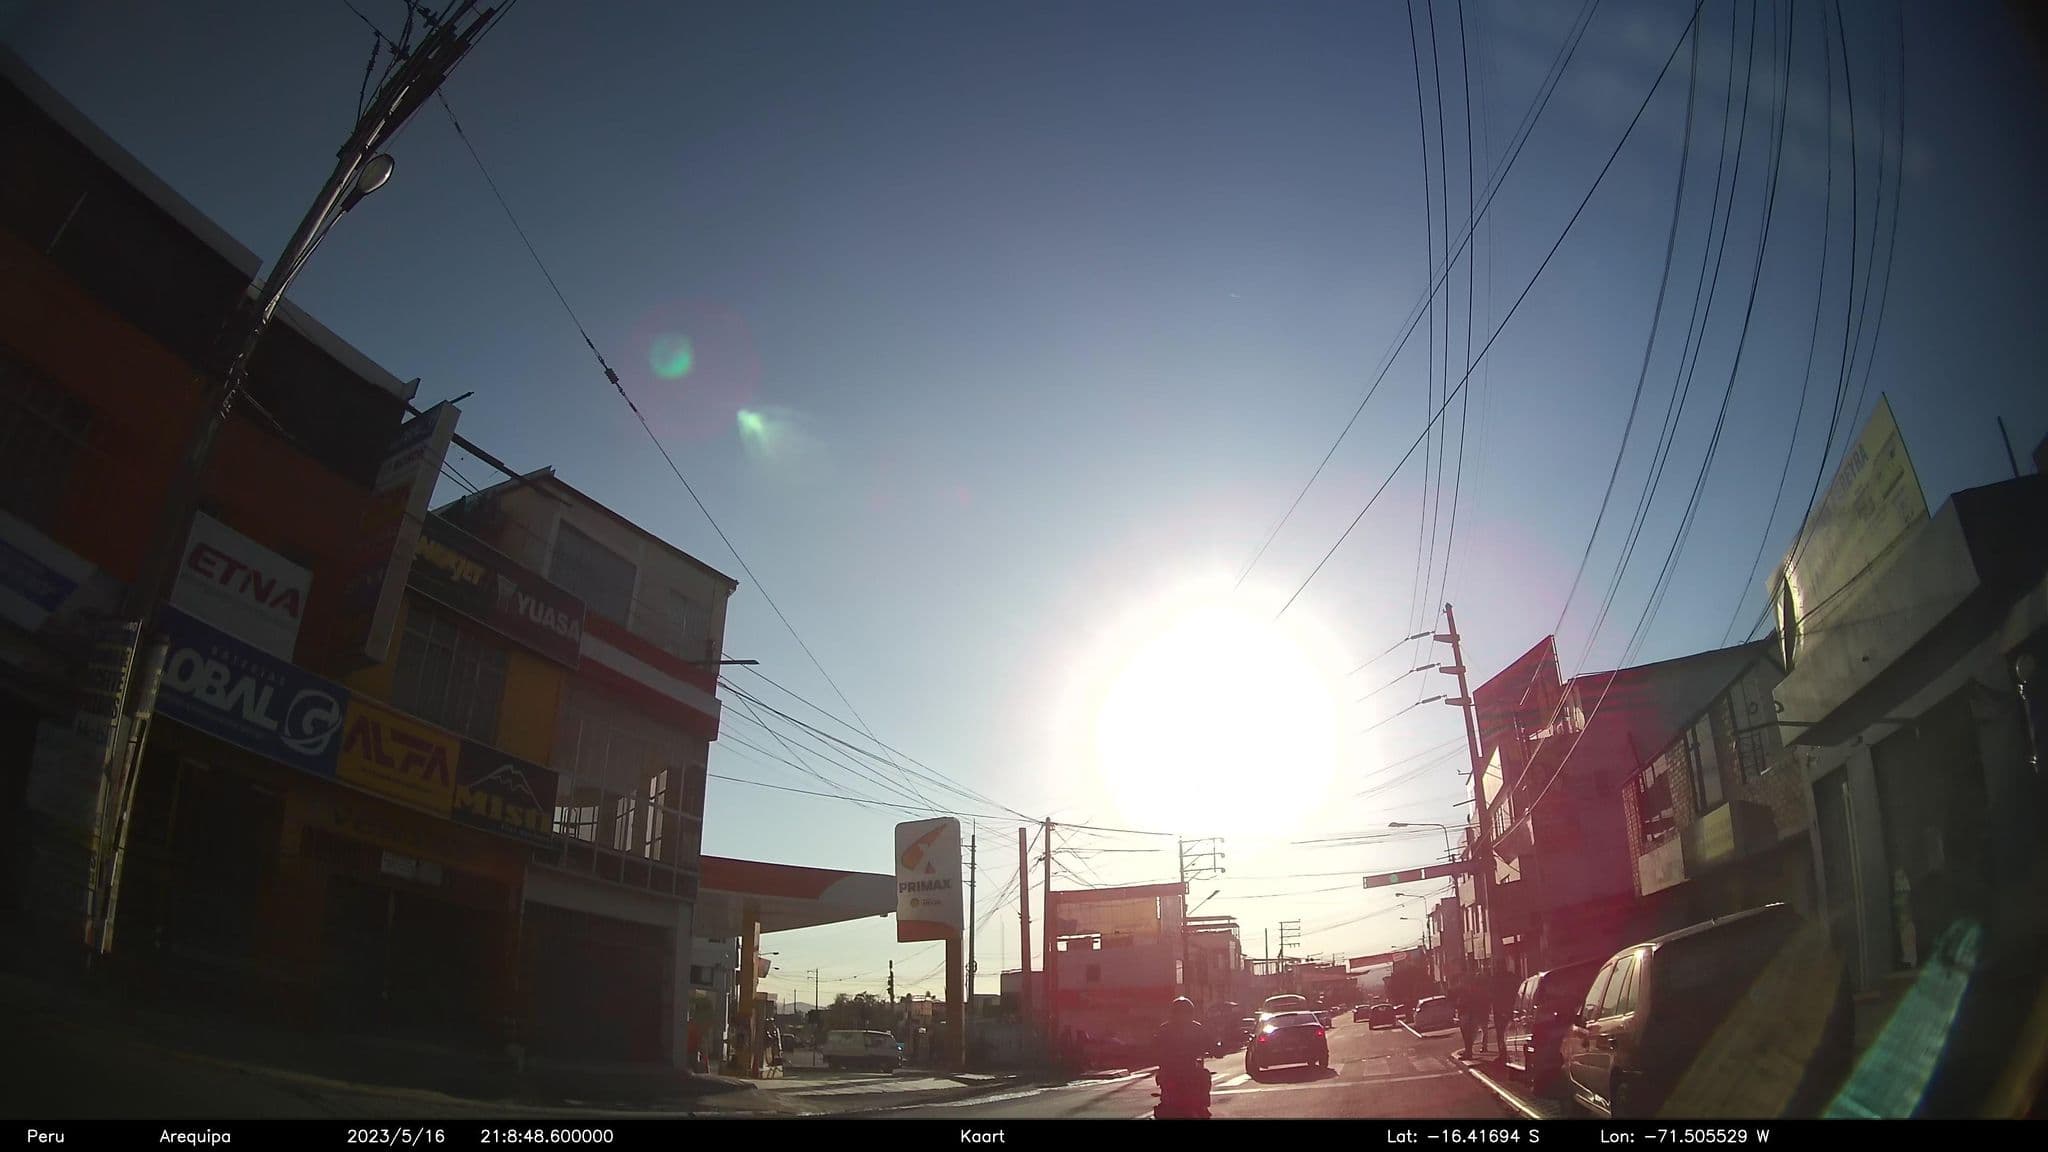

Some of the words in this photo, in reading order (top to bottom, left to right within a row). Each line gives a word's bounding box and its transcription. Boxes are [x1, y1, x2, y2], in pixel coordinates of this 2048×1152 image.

[187, 541, 301, 619] ETNA
[516, 590, 580, 642] YUASA
[161, 647, 280, 731] OBAL
[342, 714, 450, 789] ALFA
[898, 879, 953, 894] PRIMAX
